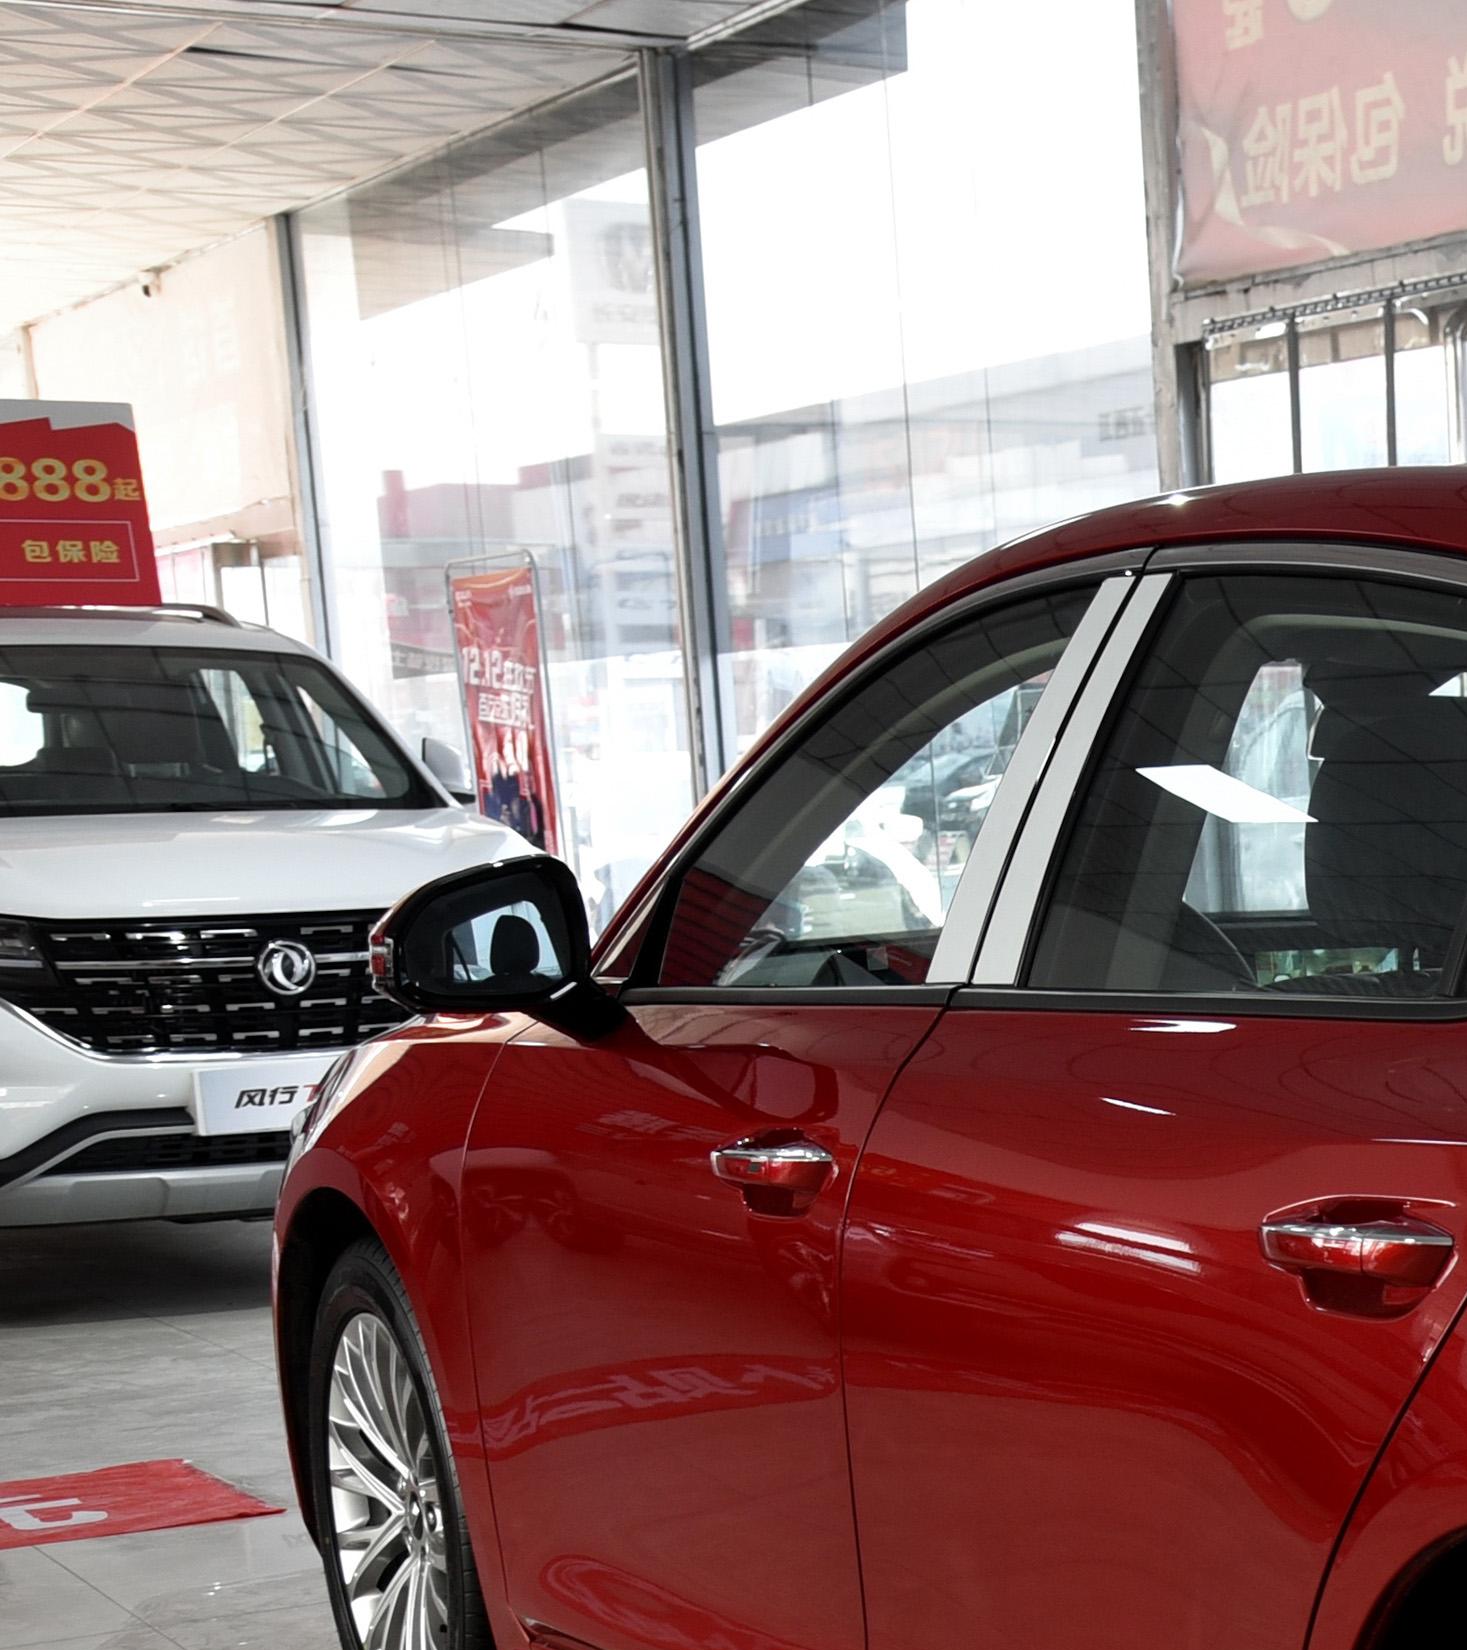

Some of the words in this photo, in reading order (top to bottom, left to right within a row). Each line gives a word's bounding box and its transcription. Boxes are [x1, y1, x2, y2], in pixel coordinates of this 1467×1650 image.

[22, 539, 121, 563] 包保险
[235, 1085, 299, 1109] 风行
